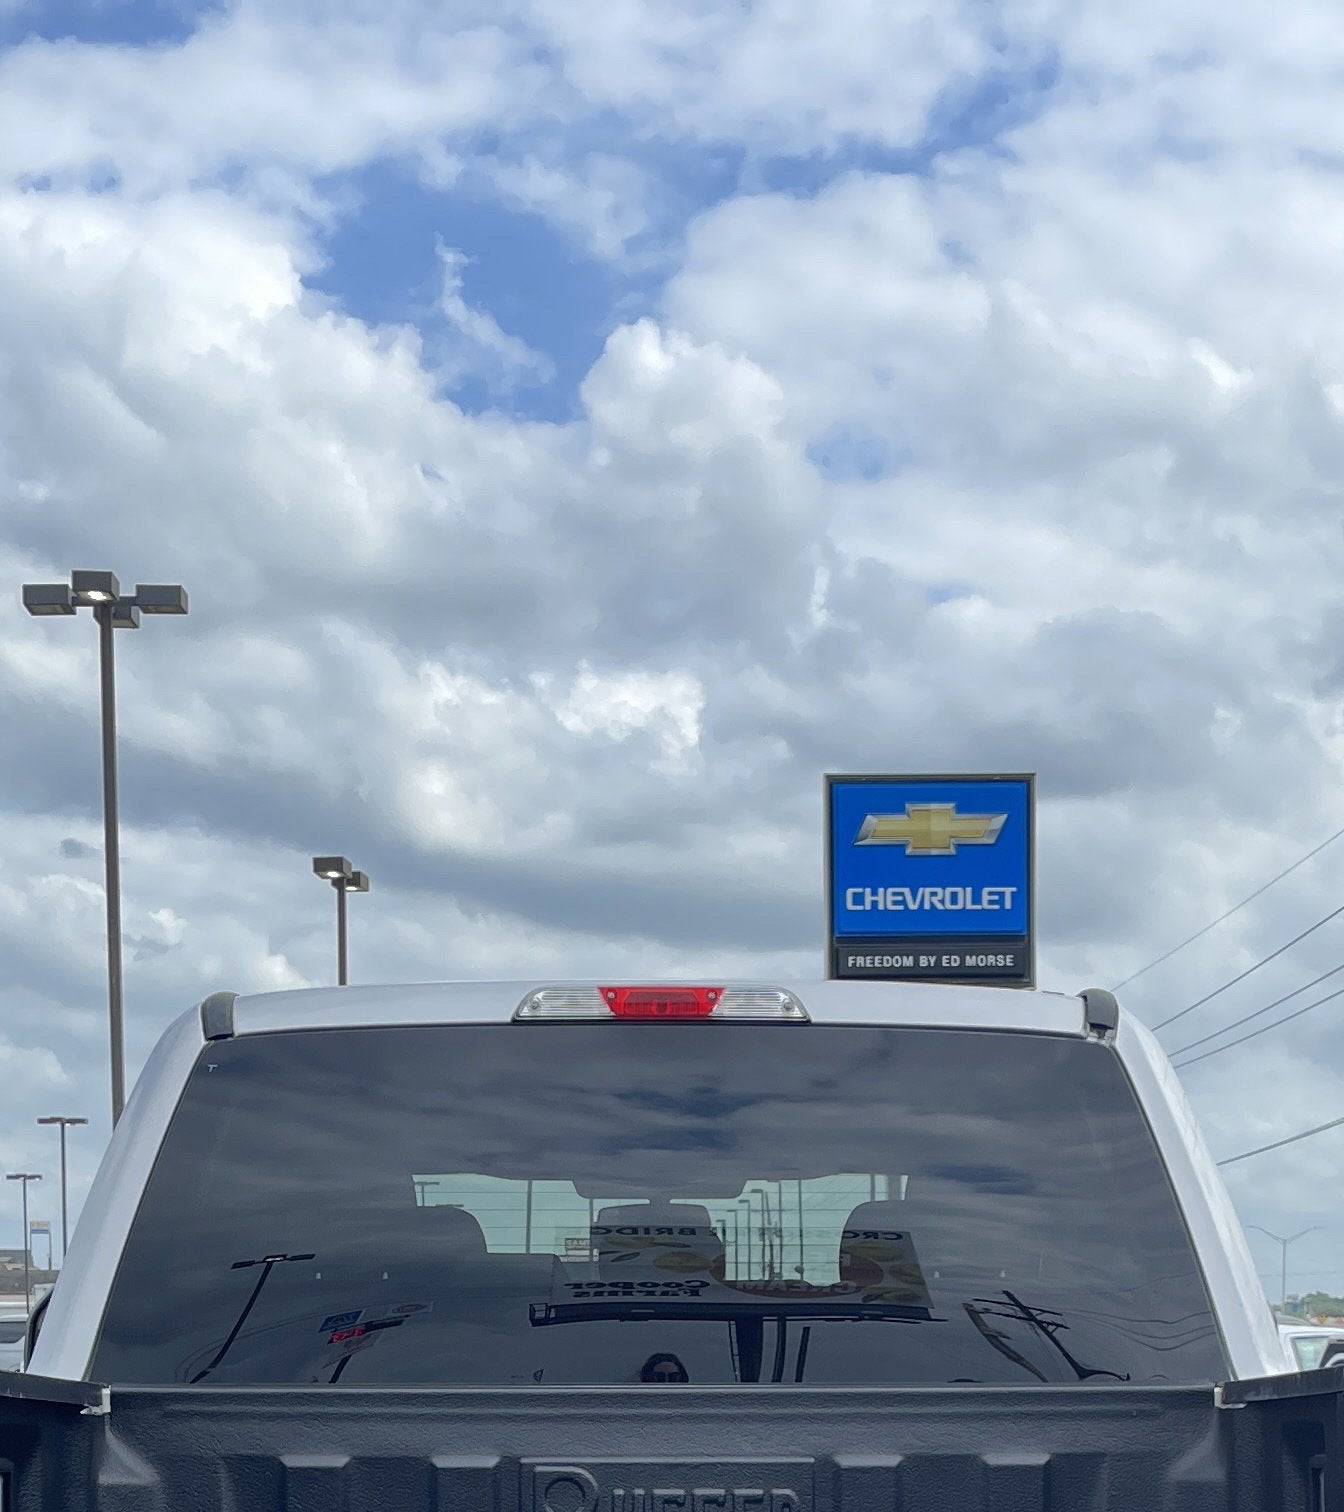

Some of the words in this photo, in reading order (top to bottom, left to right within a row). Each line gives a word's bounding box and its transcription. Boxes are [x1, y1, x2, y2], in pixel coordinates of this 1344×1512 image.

[845, 886, 1017, 911] CHEVROLET
[847, 956, 914, 968] FREEDOM
[919, 956, 937, 967] BY
[942, 955, 961, 967] ED
[965, 954, 1015, 967] MORSE
